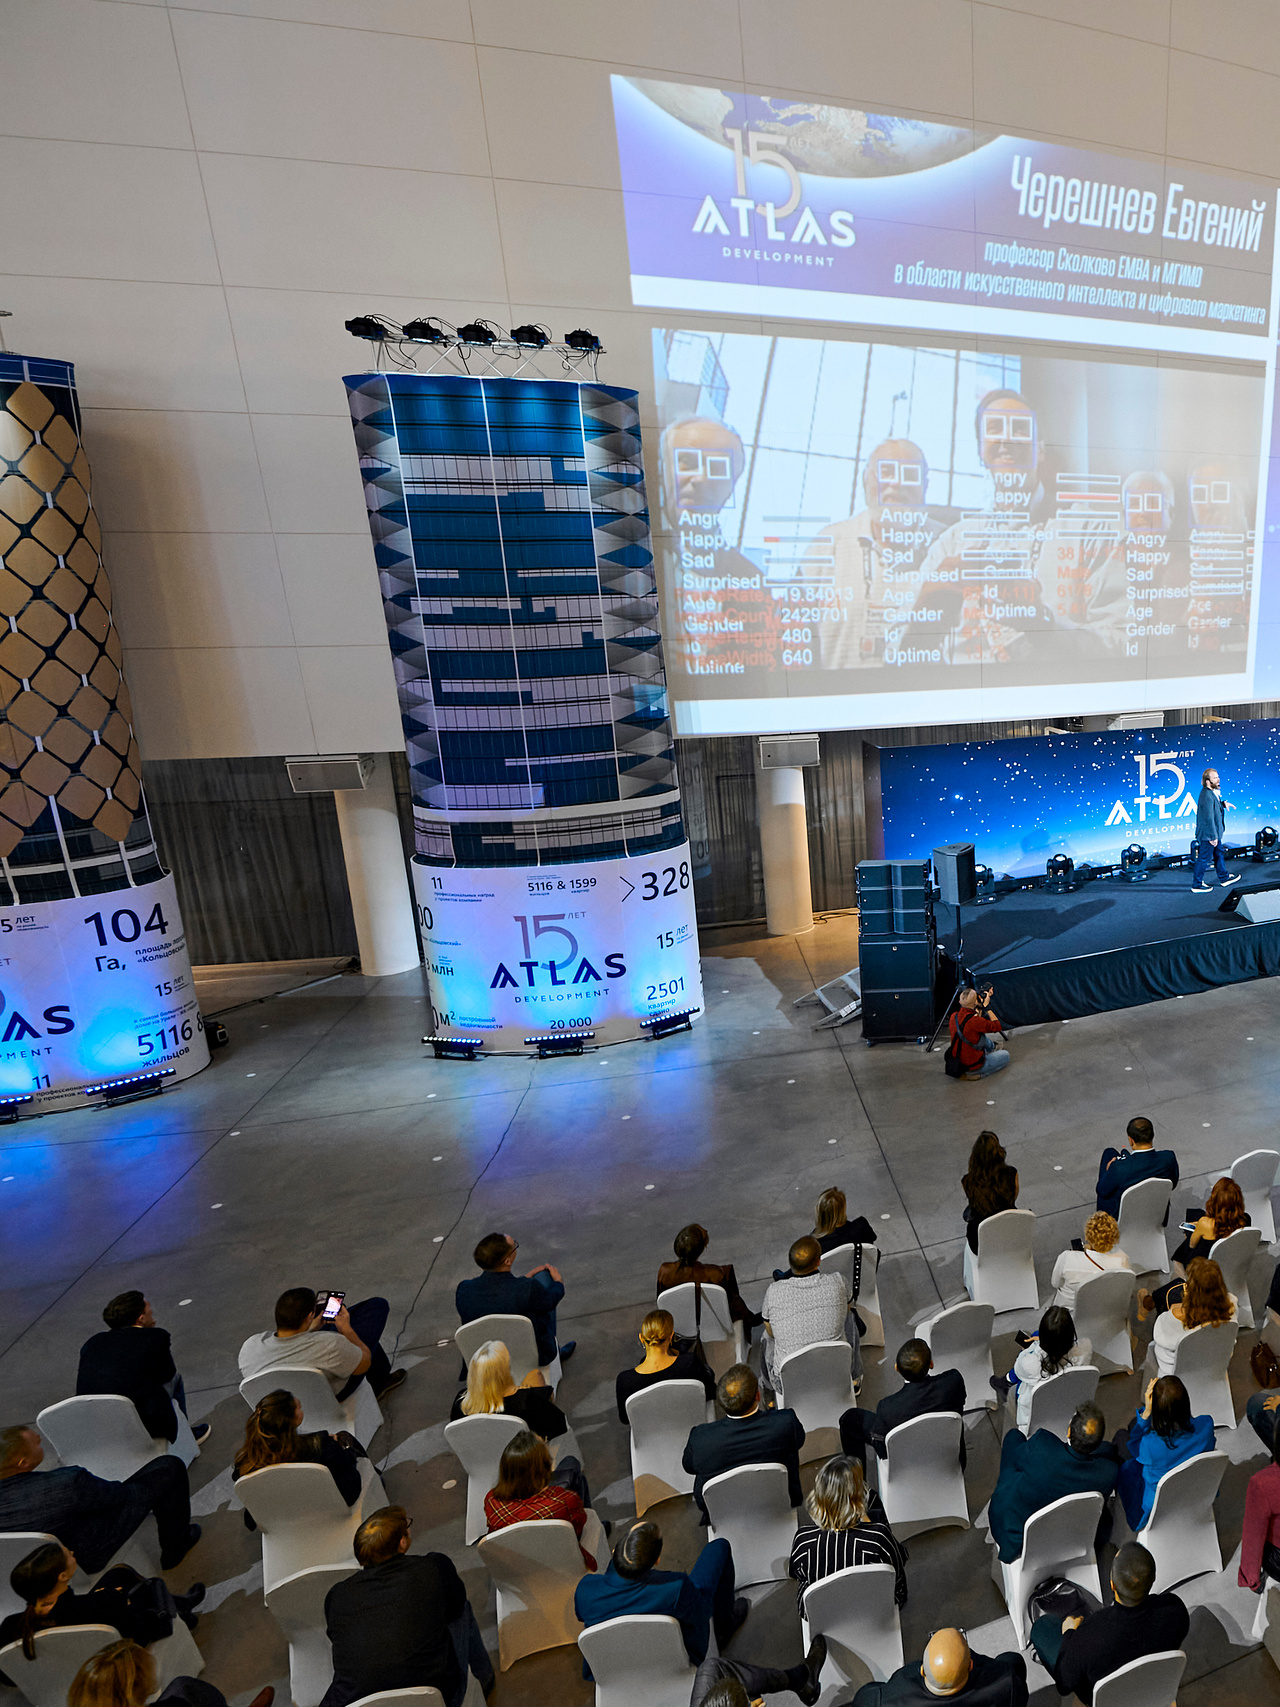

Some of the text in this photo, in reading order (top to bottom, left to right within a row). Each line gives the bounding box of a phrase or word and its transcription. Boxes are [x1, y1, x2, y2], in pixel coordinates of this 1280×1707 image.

[725, 127, 801, 218] 15
[1010, 154, 1267, 252] Черешнев Евгений
[692, 194, 857, 247] ATLAS
[722, 246, 835, 267] DEVELOPMENT
[983, 240, 1055, 273] профессор
[1056, 247, 1116, 277] Сколково
[1151, 264, 1161, 283] и
[1161, 261, 1203, 288] МГИМО
[894, 260, 1267, 325] в области искусственного интеллекта и цифрового маркетинга
[992, 491, 1031, 507] appy
[679, 509, 720, 529] Angr
[880, 508, 929, 527] Angry
[881, 528, 934, 547] Happy
[1126, 532, 1166, 548] Angry
[681, 551, 715, 569] Sad
[882, 547, 914, 563] Sad
[1126, 550, 1171, 565] Happy
[883, 568, 960, 584] Surprised
[1126, 567, 1154, 581] Sad
[682, 573, 761, 592] Surprised
[882, 588, 915, 606] Age
[984, 584, 998, 598] Id
[1126, 585, 1189, 602] Surprised
[781, 607, 848, 623] 2429701
[882, 607, 944, 622] Gender
[984, 603, 1037, 620] Uptime
[1126, 605, 1153, 620] Age
[782, 628, 812, 644] 480
[884, 627, 899, 643] Id
[1126, 622, 1176, 637] Gender
[884, 647, 941, 666] Uptime
[1126, 641, 1139, 656] Id
[782, 649, 813, 665] 640
[1133, 751, 1186, 805] 15
[1104, 791, 1198, 826] ATLA
[431, 876, 443, 889] 11
[528, 881, 553, 892] 5116
[557, 880, 567, 890] &
[569, 877, 597, 889] 1599
[641, 861, 691, 901] 328
[15, 915, 36, 925] лет
[567, 911, 587, 919] ЛЕТ
[84, 902, 169, 947] 104
[513, 913, 579, 970] 15
[656, 931, 674, 949] 15
[95, 955, 126, 972] Га,
[431, 963, 454, 976] млн
[489, 953, 627, 989] ATLAS
[155, 981, 173, 997] 15
[514, 988, 610, 1003] DEVELOPMENT
[646, 976, 685, 1001] 2501
[647, 998, 676, 1010] квартир
[549, 1016, 592, 1030] 20 000
[137, 1018, 193, 1056] 5116
[142, 1046, 190, 1068] жильцов
[32, 1074, 51, 1090] 11
[43, 1093, 76, 1101] проектов
